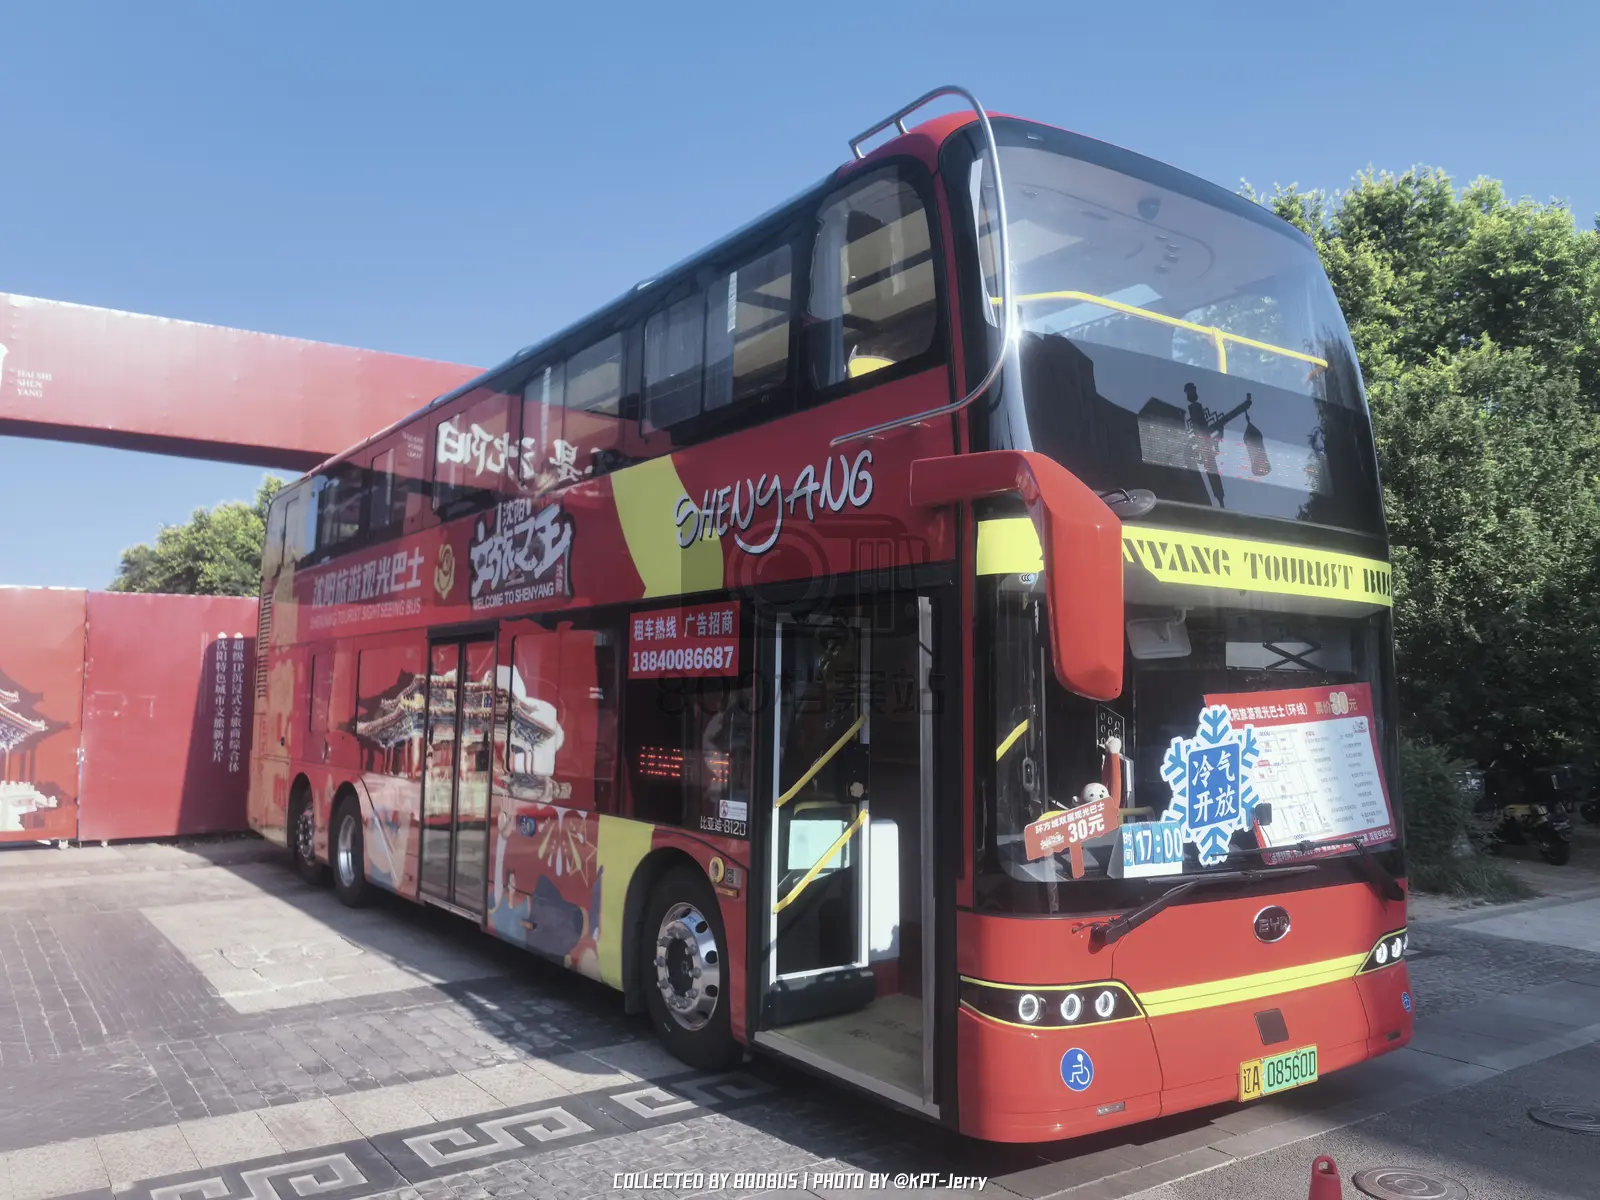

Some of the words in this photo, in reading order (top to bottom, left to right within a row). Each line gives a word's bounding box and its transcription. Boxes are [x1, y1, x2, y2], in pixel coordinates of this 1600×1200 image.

[673, 450, 874, 555] SHENYANG
[1244, 551, 1353, 590] TOURIST
[406, 597, 422, 615] BUS
[505, 590, 514, 605] TO
[515, 582, 554, 602] SHENYANG
[633, 615, 677, 642] 租车热线
[684, 609, 734, 638] 广告招商
[632, 646, 734, 672] 18840086687
[1191, 750, 1236, 789] 冷气
[1193, 784, 1237, 824] 开放
[1068, 814, 1105, 844] 30元
[1135, 828, 1183, 861] 17:00
[1123, 832, 1132, 863] 时间
[1258, 916, 1289, 933] BYD
